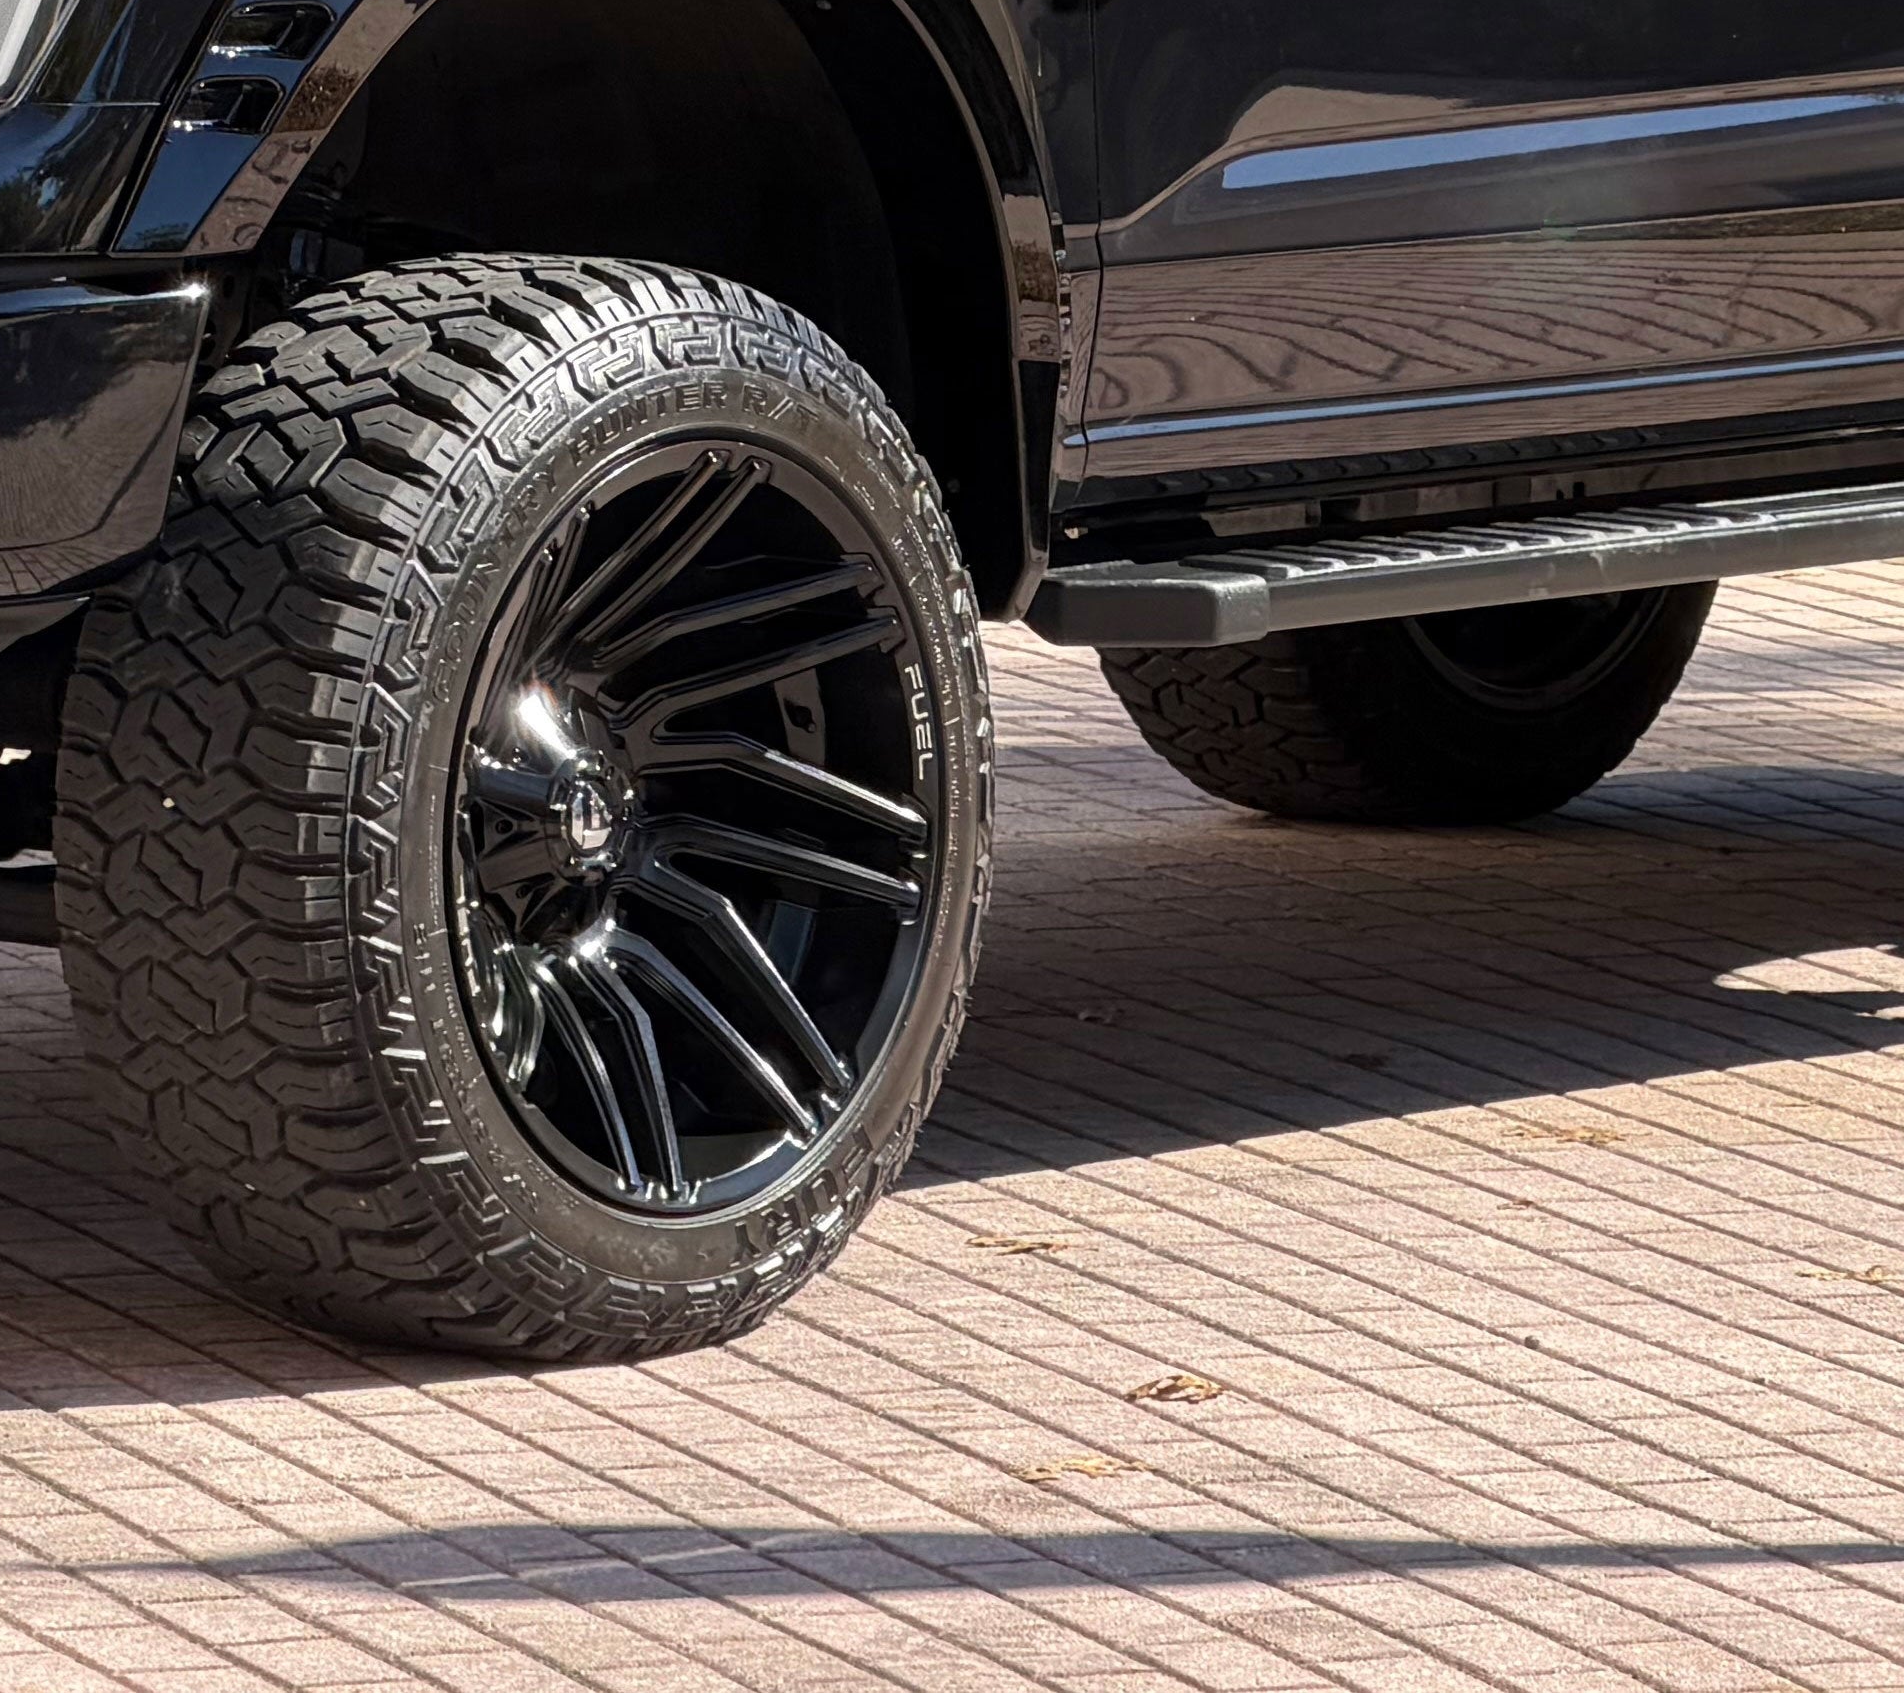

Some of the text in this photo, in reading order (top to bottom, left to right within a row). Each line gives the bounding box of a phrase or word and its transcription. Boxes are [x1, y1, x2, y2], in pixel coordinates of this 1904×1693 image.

[566, 379, 730, 469] HUNTER
[904, 662, 934, 781] FUEL
[729, 1122, 875, 1268] FURY
